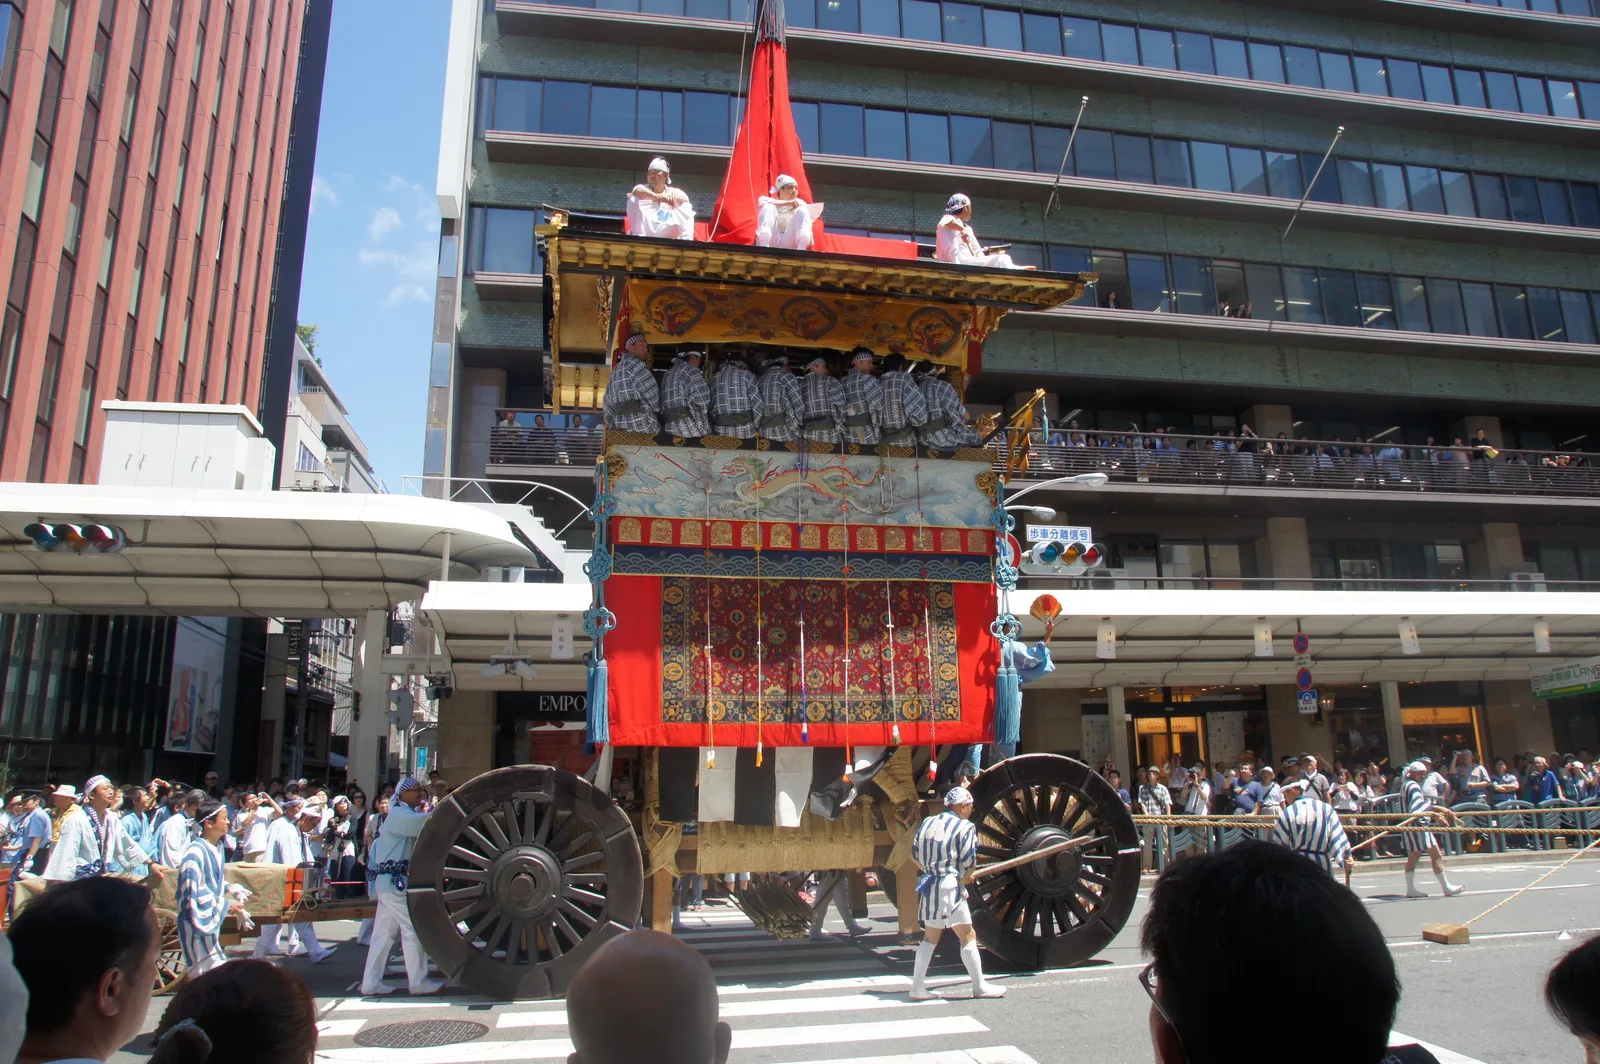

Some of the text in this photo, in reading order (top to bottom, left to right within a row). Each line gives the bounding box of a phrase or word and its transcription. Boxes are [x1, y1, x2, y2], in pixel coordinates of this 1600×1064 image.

[1030, 528, 1089, 541] 歩車分離信号
